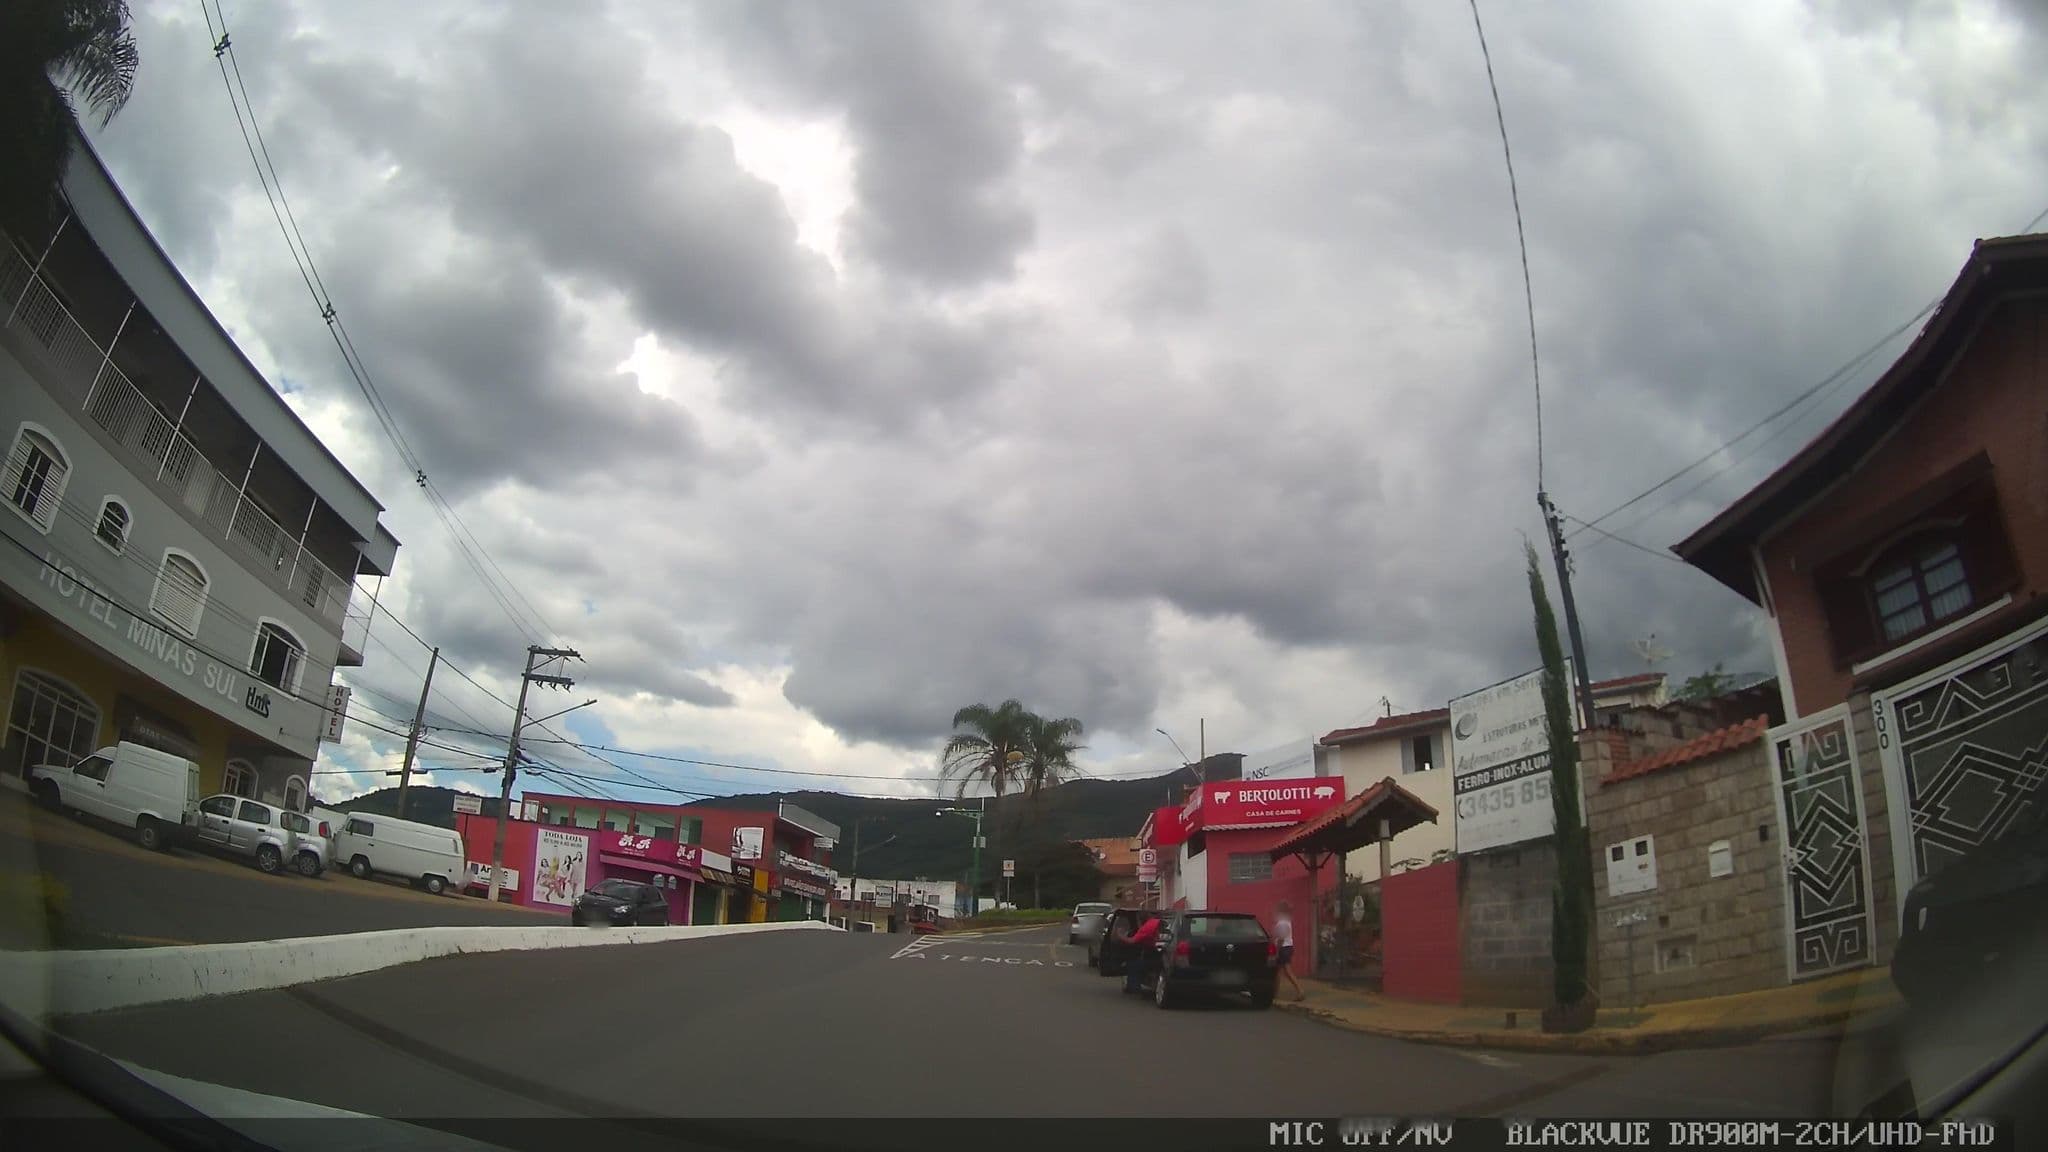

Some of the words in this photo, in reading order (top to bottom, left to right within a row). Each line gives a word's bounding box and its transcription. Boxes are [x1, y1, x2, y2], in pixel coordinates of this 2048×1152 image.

[39, 551, 118, 630] HOTEL
[126, 614, 199, 677] MINAS
[203, 662, 238, 703] SUL
[329, 687, 344, 737] HOTEL
[1874, 699, 1889, 750] 300
[1239, 787, 1311, 806] BERTOLOTTI
